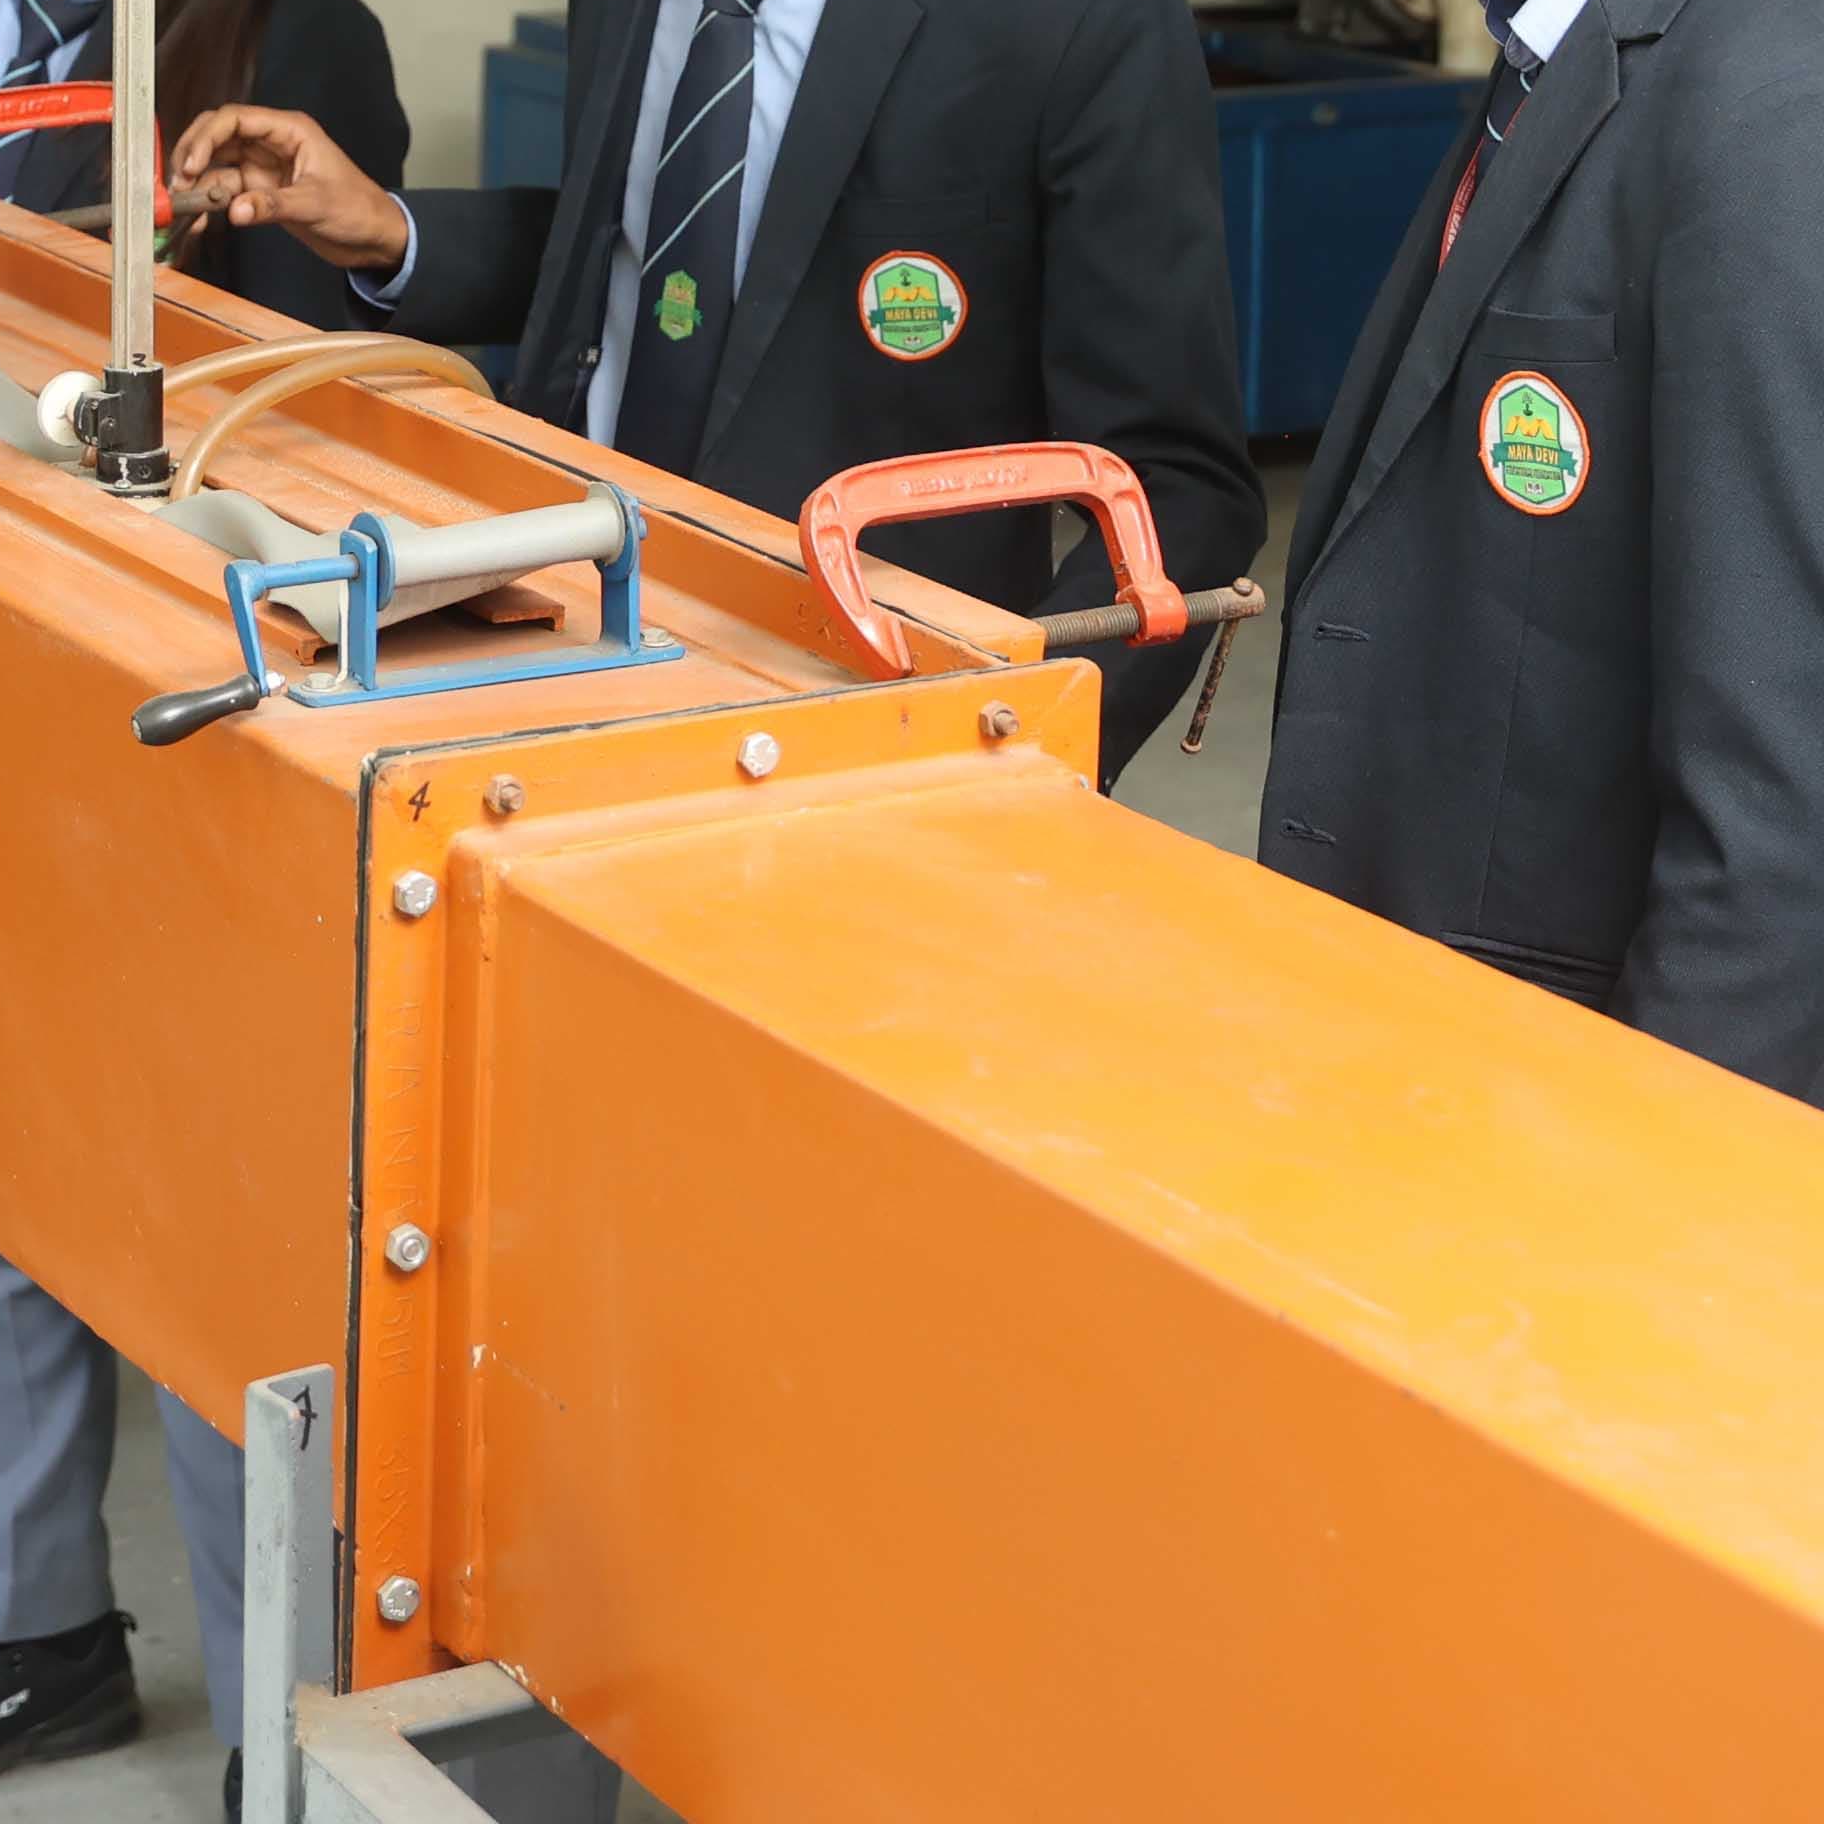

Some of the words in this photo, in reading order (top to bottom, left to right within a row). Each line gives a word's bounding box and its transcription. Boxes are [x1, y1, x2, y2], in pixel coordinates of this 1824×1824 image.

[1508, 444, 1534, 461] MAYA
[1535, 446, 1559, 465] DEVI
[408, 780, 433, 823] 4
